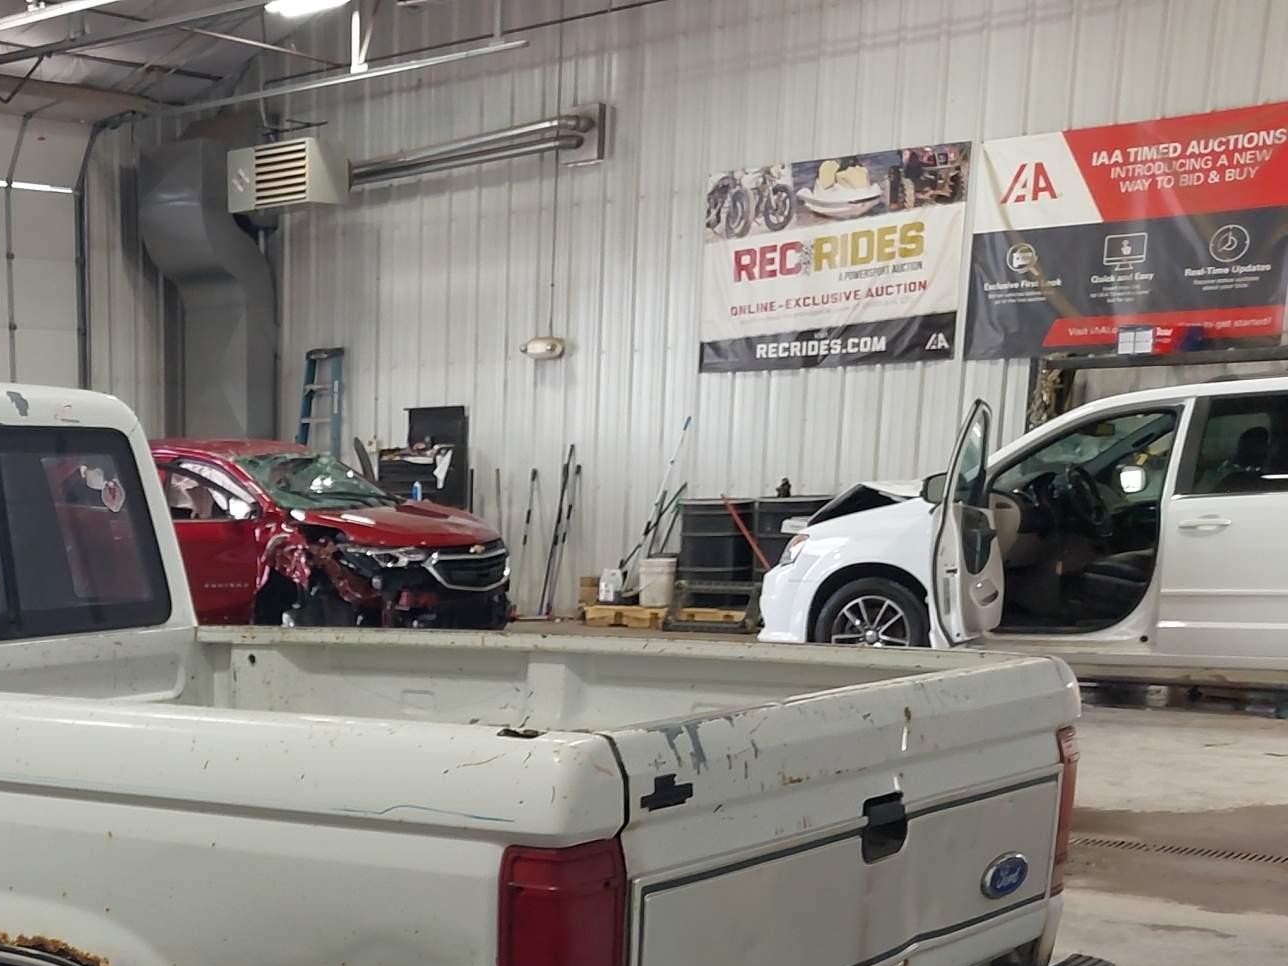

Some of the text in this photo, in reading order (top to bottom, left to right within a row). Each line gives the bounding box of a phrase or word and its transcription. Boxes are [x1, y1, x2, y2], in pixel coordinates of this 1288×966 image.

[1091, 127, 1288, 167] IAA TIMED AUCTIONS
[1110, 149, 1273, 179] INTRODUCING A NEW
[1119, 165, 1260, 193] WAY TO BID & BUY
[813, 221, 926, 272] RIDES
[892, 261, 923, 274] AUCTION
[1231, 263, 1272, 274] Updates
[730, 279, 929, 316] ONLINE-EXCLUSIVE AUCTION
[755, 336, 887, 359] RECRIDES.COM
